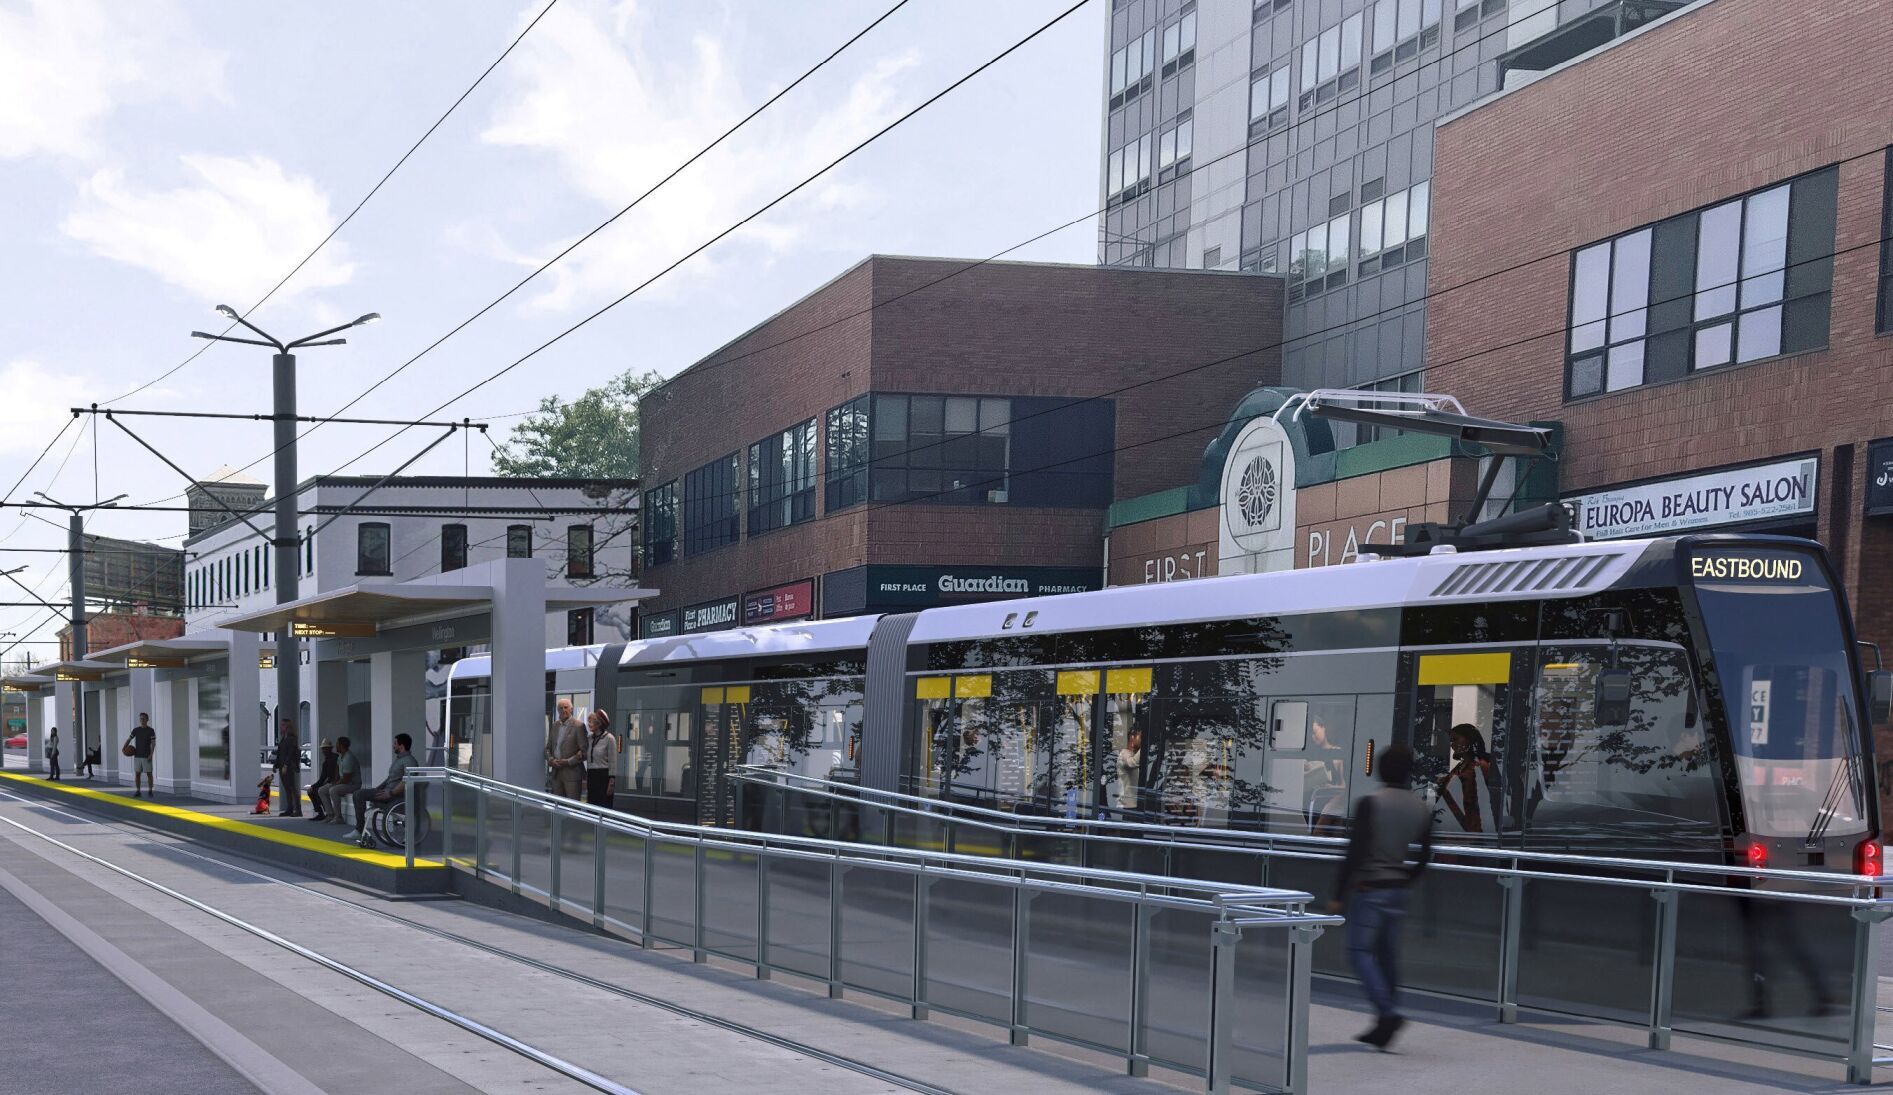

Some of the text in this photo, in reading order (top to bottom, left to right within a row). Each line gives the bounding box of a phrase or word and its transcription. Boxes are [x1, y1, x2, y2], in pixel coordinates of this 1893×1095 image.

[1586, 474, 1808, 529] EUROPA BEAUTY SALON
[1625, 525, 1640, 533] Care
[1641, 523, 1652, 532] for
[1654, 520, 1670, 529] Men
[1680, 516, 1708, 526] Women
[1691, 557, 1802, 579] EASTBOUND
[880, 574, 1088, 593] FIRST PLACE Guardian PHARMACY
[685, 610, 697, 621] First
[697, 602, 737, 627] PHARMACY
